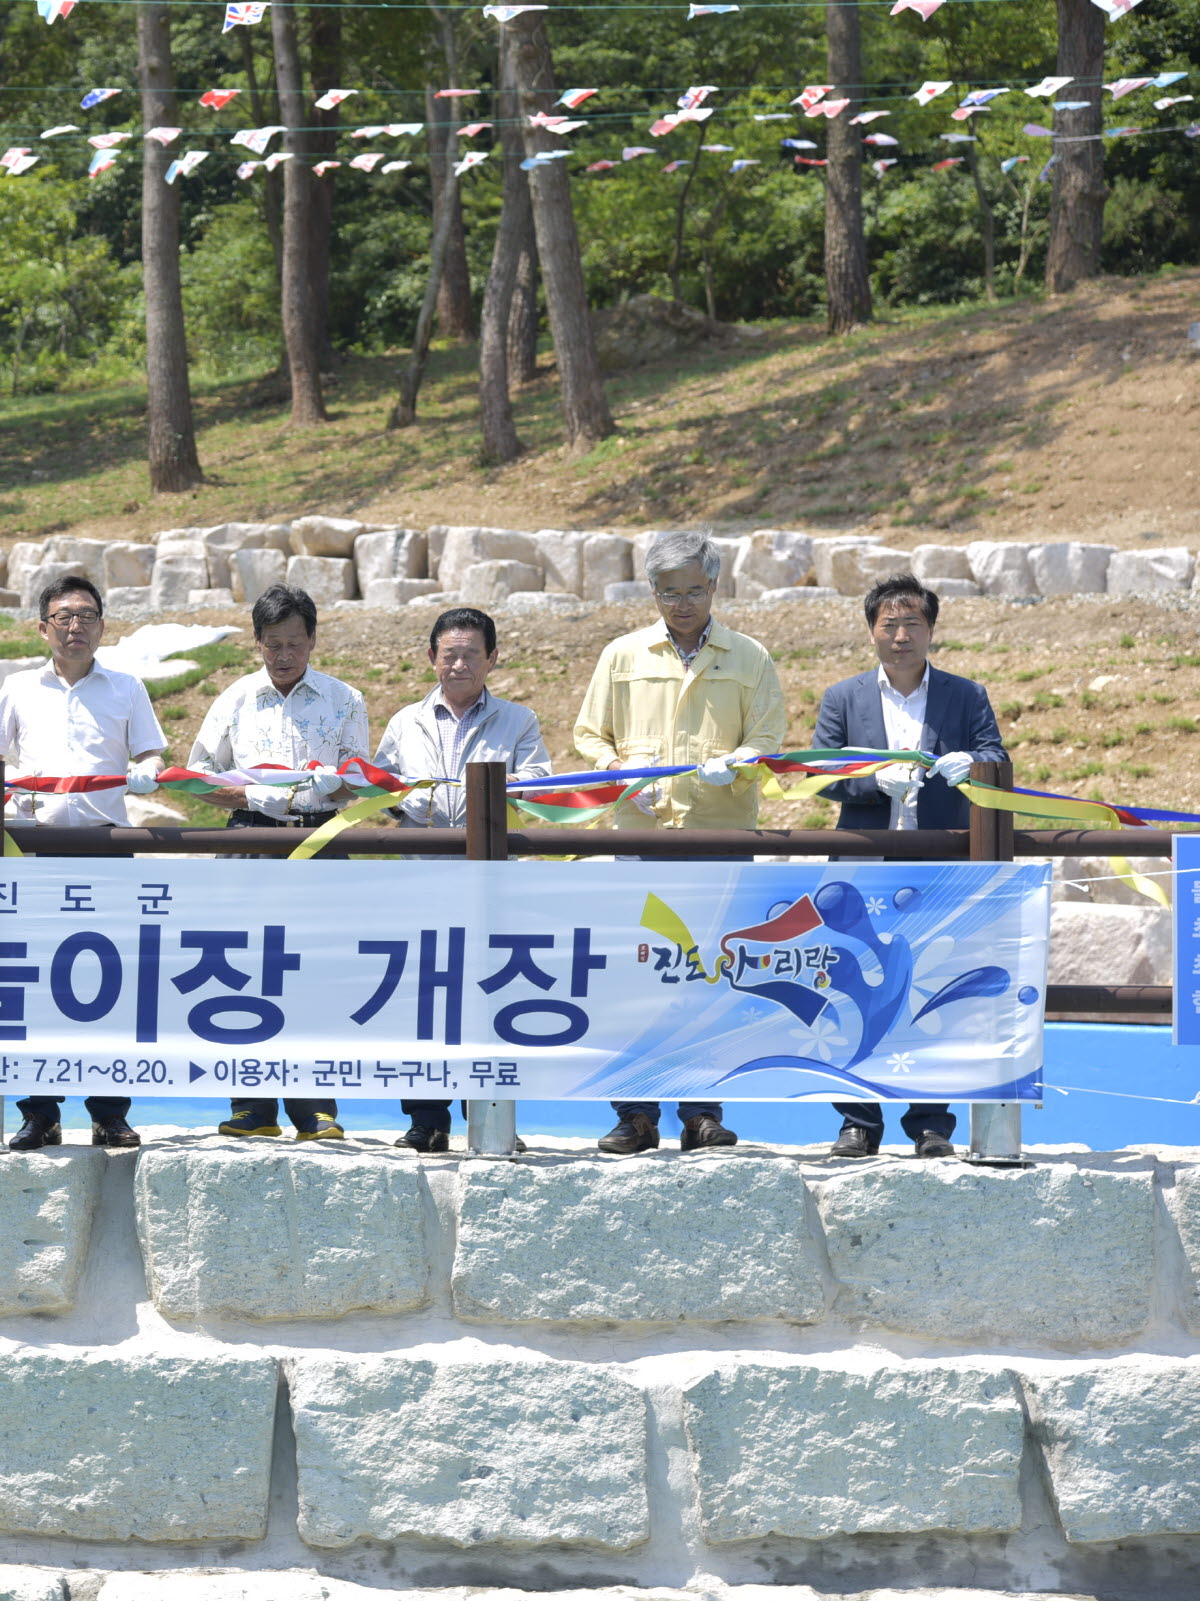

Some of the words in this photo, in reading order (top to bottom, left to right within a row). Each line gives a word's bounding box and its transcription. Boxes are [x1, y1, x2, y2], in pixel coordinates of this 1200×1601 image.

[349, 926, 607, 1046] 개장
[32, 1058, 174, 1085] 7.21~8.20.
[214, 1059, 299, 1087] 이용자:
[311, 1060, 362, 1087] 군민
[373, 1060, 458, 1090] 누구나,
[469, 1061, 521, 1088] 무료
